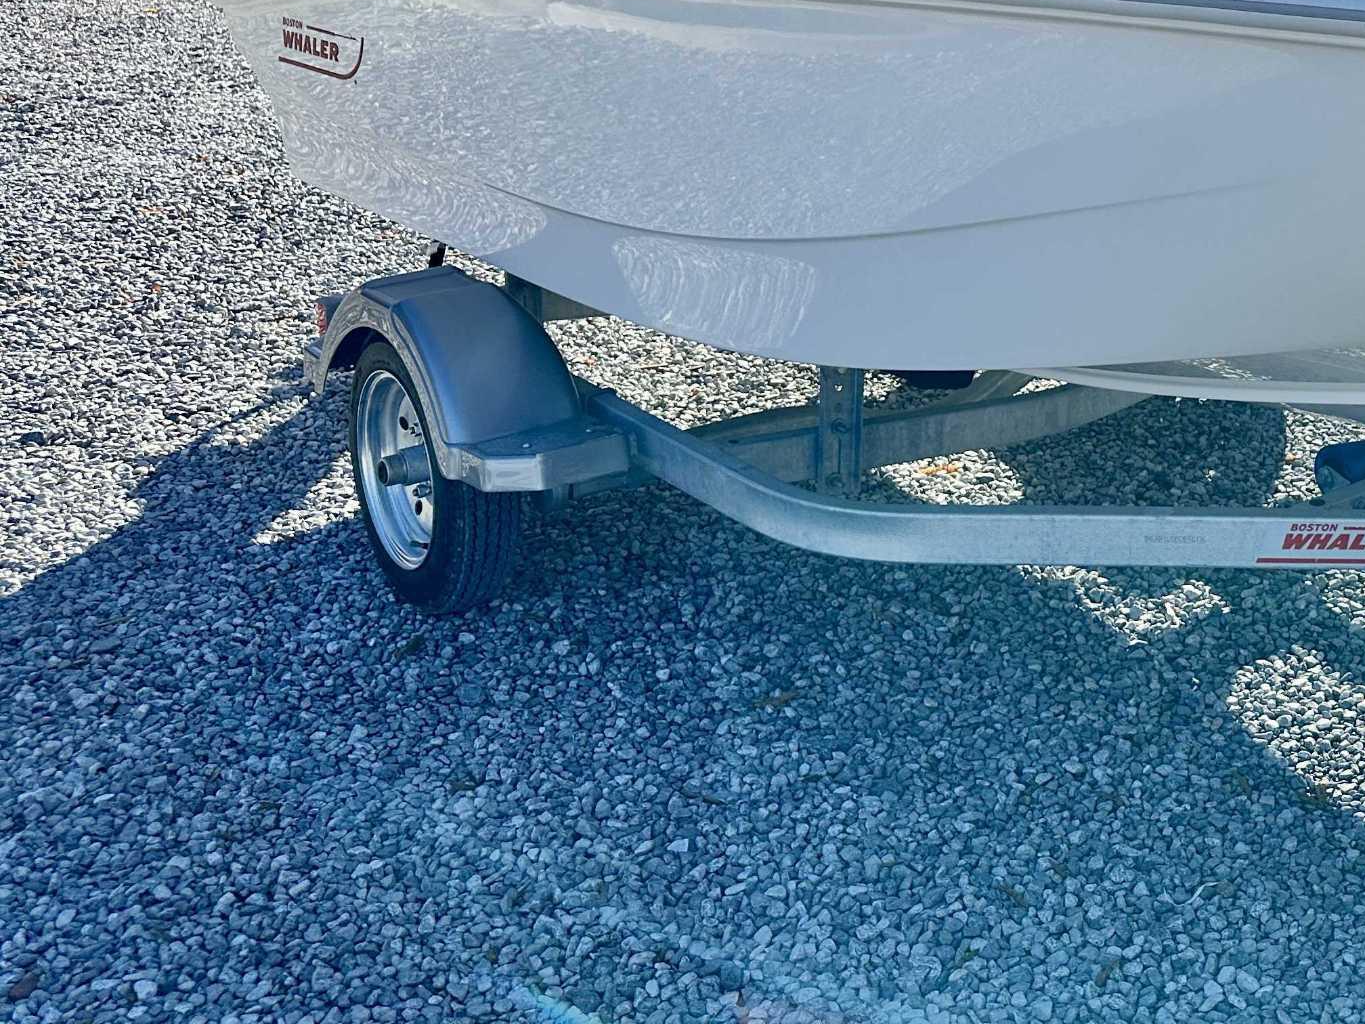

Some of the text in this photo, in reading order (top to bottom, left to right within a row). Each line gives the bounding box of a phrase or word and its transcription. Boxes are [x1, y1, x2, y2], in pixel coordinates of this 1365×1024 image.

[282, 17, 303, 30] BOSTON
[282, 29, 340, 62] WHALER
[1290, 523, 1338, 532] BOSTON
